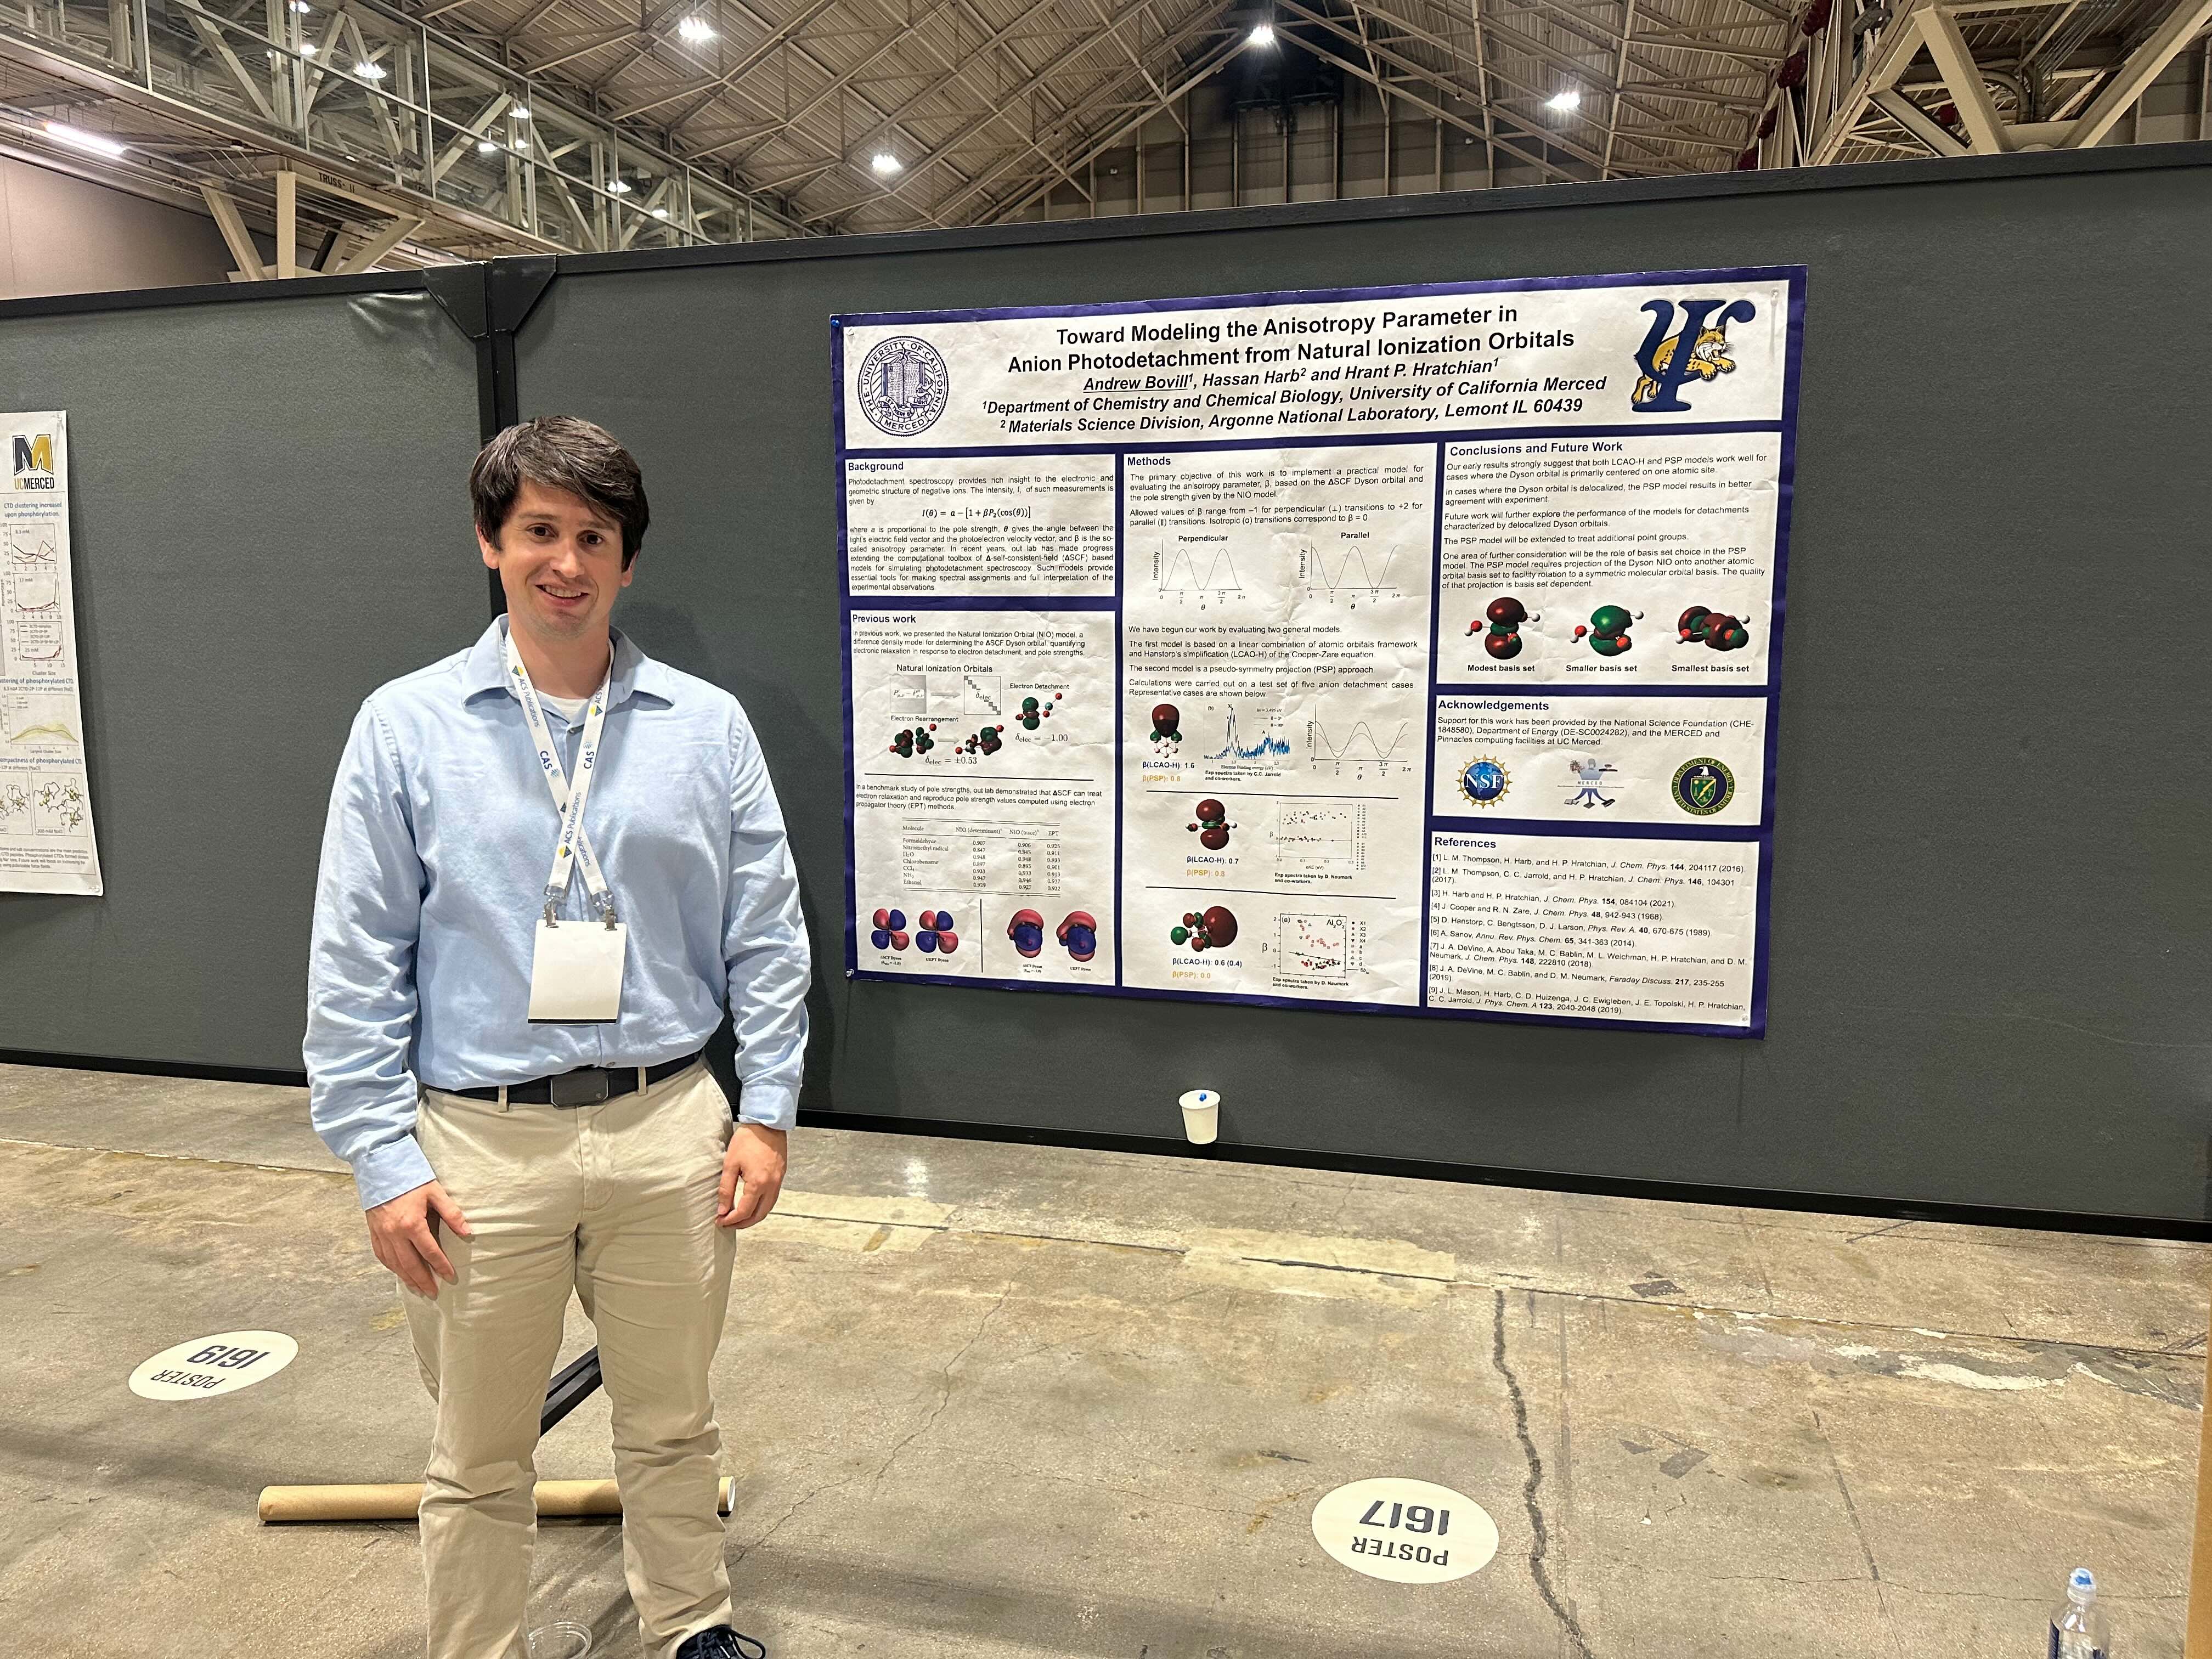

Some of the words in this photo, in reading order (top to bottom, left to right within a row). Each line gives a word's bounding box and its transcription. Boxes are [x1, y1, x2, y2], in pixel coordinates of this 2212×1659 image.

[1057, 326, 1124, 345] Toward
[1131, 323, 1220, 342] Modeling
[1227, 320, 1257, 337] the
[1263, 316, 1375, 336] Anisotropy
[1383, 307, 1492, 329] Parameter
[1499, 305, 1516, 322] in
[911, 343, 923, 352] OF
[1008, 356, 1061, 373] Anion
[1069, 347, 1239, 370] Photodetachment
[1245, 346, 1290, 363] from
[1297, 340, 1370, 360] Natural
[1378, 335, 1480, 356] Ionization
[1488, 329, 1574, 349] Orbitals
[864, 342, 905, 385] UNIVERSITY
[924, 352, 943, 413] CALIFORNIA
[1083, 377, 1141, 391] Andrew
[1202, 373, 1259, 387] Hassan
[1311, 366, 1341, 381] and
[1345, 364, 1390, 380] Hrant
[1393, 363, 1406, 377] P.
[864, 391, 874, 413] THE
[1074, 398, 1090, 411] of
[1093, 396, 1170, 412] Chemistry
[1173, 394, 1201, 409] and
[1206, 391, 1277, 407] Chemical
[1279, 388, 1343, 405] Biology,
[1350, 384, 1432, 400] University
[1436, 382, 1455, 396] of
[1458, 378, 1538, 395] California
[1543, 376, 1607, 391] Merced
[884, 419, 924, 430] MERCED
[1008, 418, 1073, 433] Materials
[1077, 417, 1135, 431] Science
[1139, 415, 1204, 430] Division,
[1208, 414, 1273, 429] Argonne
[1278, 408, 1343, 424] National
[1347, 406, 1438, 421] Laboratory,
[1444, 400, 1509, 417] Lemont
[1512, 399, 1527, 414] IL
[1533, 398, 1582, 413] 60439
[1450, 444, 1522, 456] Conclusions
[1525, 443, 1547, 453] and
[1551, 443, 1588, 452] Future
[1592, 441, 1623, 452] Work
[848, 461, 903, 472] Background
[1127, 456, 1171, 466] Methods
[958, 477, 986, 486] provides
[1008, 476, 1030, 484] insight
[1178, 535, 1228, 543] Perpendicular
[1637, 534, 1657, 543] point
[853, 614, 890, 623] Previous
[892, 614, 916, 623] work
[1161, 626, 1183, 634] begun
[1218, 626, 1227, 634] by
[1229, 626, 1265, 635] evaluating
[1283, 625, 1310, 635] general
[518, 678, 528, 691] ACS
[522, 691, 540, 727] Publications
[1438, 699, 1549, 712] Acknowledgements
[1475, 737, 1513, 745] computing
[540, 751, 553, 770] CAS
[584, 751, 594, 769] CAS
[1465, 774, 1503, 788] NSF
[567, 792, 581, 830] Publications
[1435, 837, 1496, 848] References
[577, 837, 590, 867] blications
[187, 1345, 271, 1369] 1619
[150, 1369, 226, 1389] POSTER
[1359, 1500, 1450, 1536] 1617
[1351, 1536, 1448, 1566] POSTER
